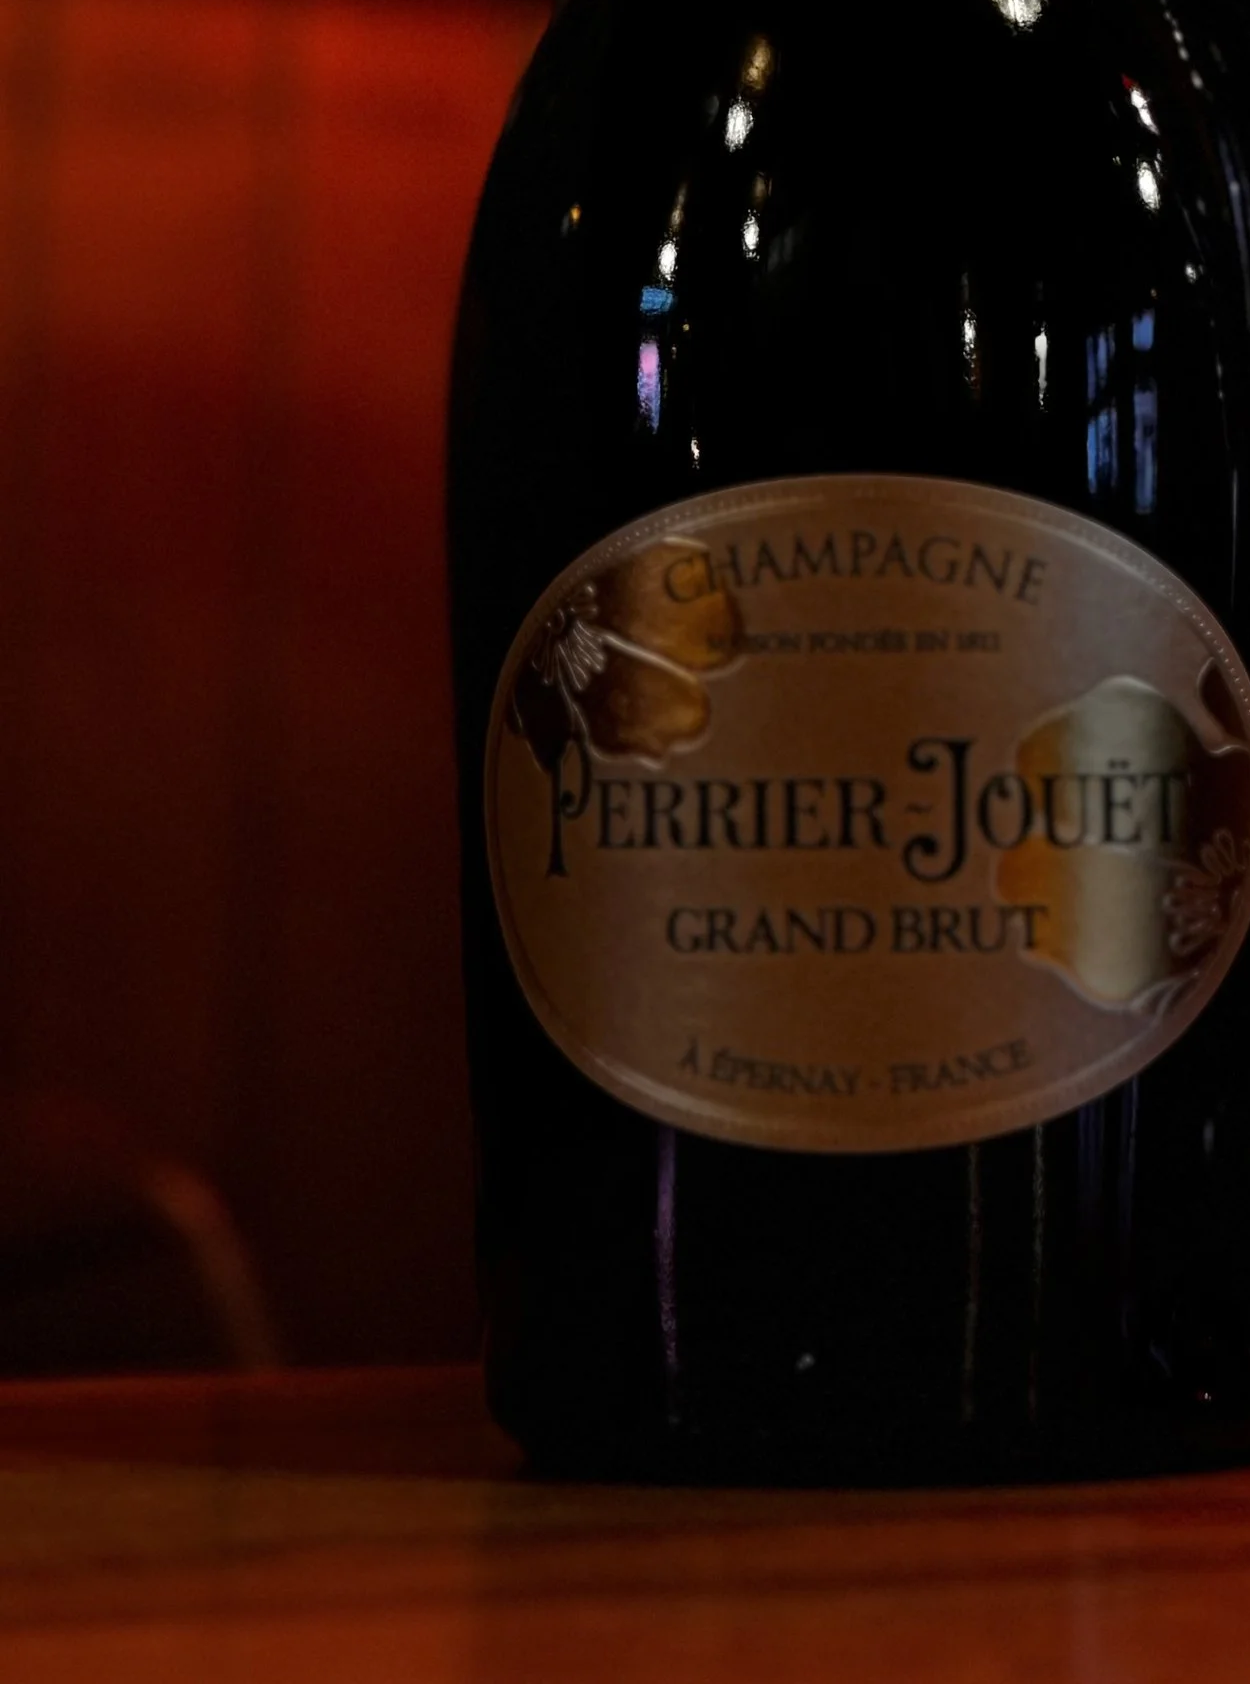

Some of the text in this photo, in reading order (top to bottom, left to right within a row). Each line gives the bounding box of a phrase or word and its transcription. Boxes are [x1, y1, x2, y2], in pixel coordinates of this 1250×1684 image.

[663, 530, 1047, 605] CHAMPAGNE
[667, 906, 1049, 954] GRAND BRUT
[888, 1039, 1033, 1094] FRANCE
